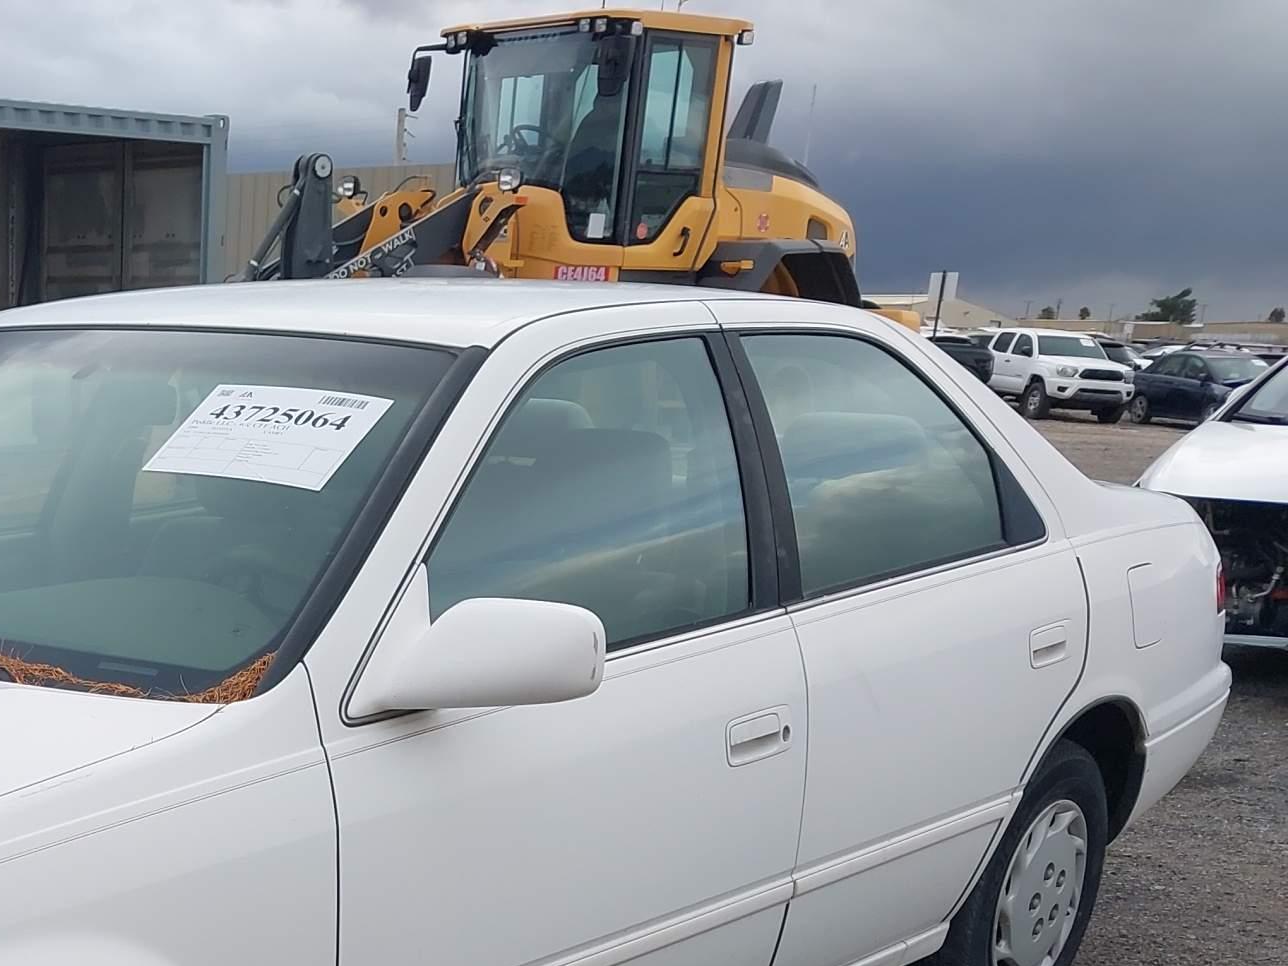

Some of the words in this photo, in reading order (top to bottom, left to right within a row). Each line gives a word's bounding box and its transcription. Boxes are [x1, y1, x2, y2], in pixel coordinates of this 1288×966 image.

[349, 251, 372, 274] NOT
[381, 229, 413, 254] WALK
[209, 403, 352, 431] 43725064
